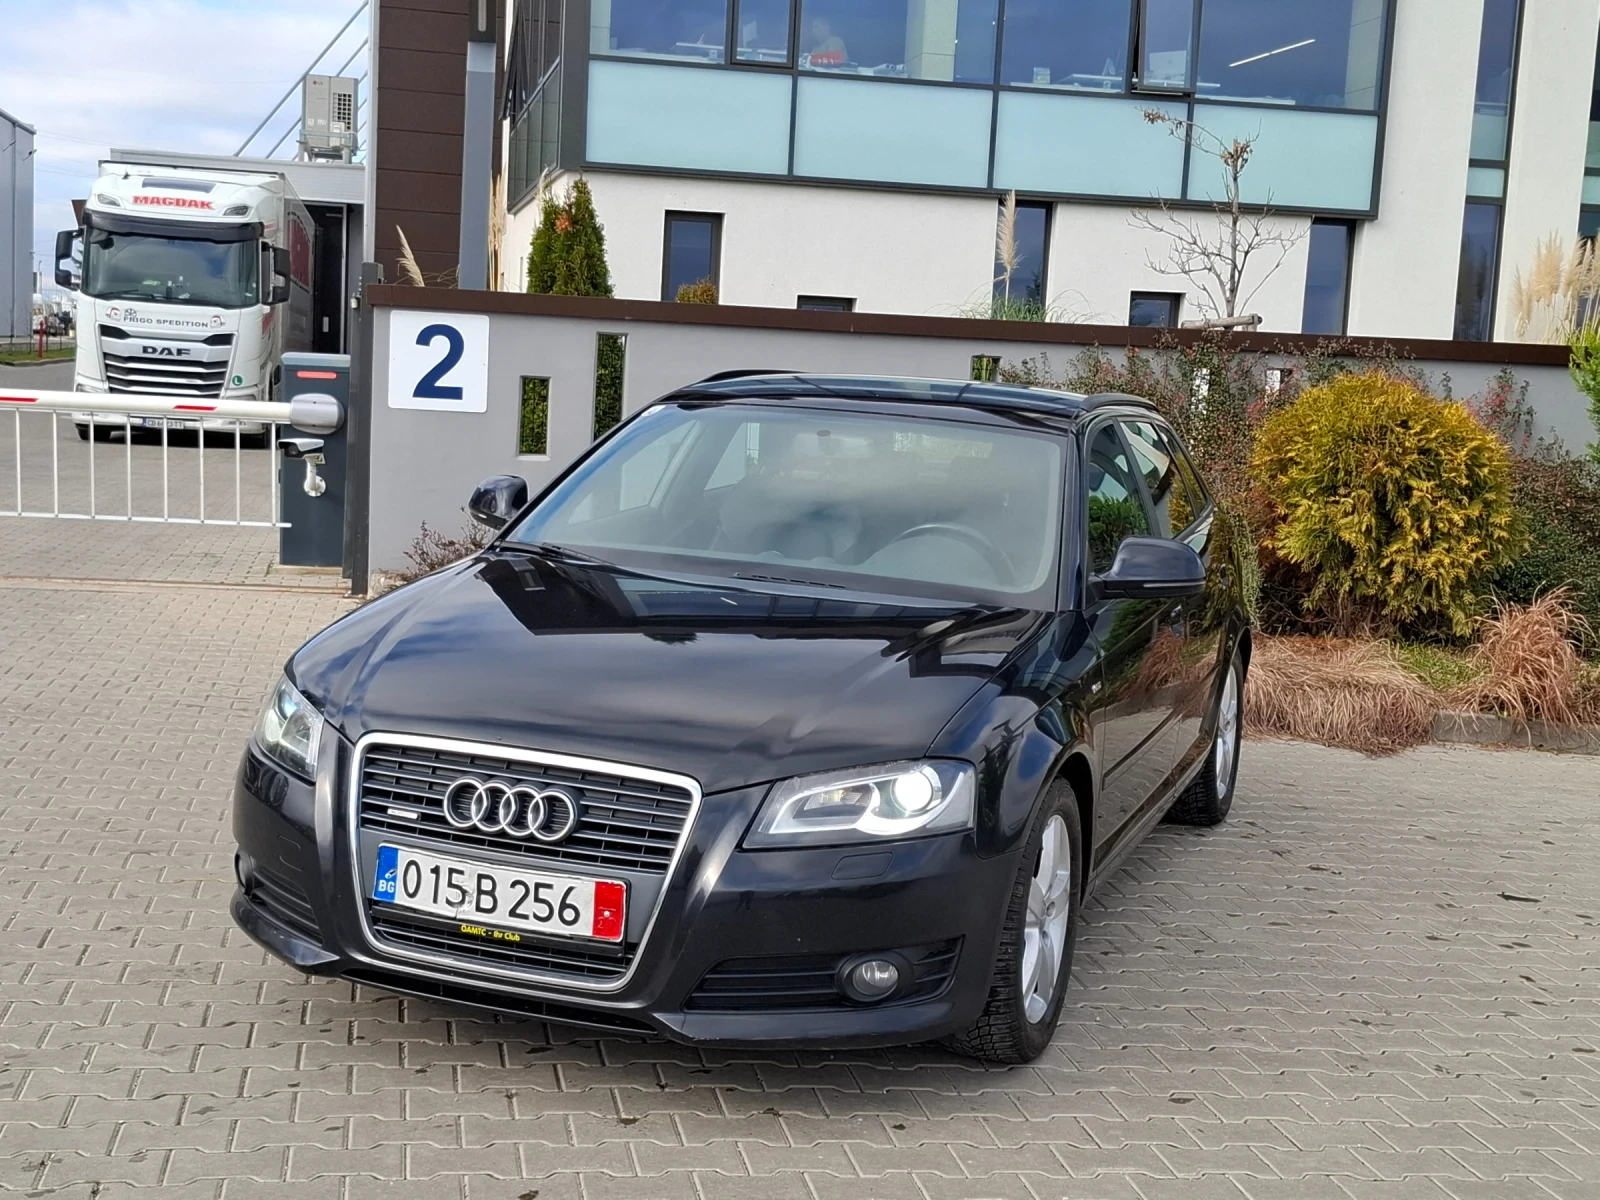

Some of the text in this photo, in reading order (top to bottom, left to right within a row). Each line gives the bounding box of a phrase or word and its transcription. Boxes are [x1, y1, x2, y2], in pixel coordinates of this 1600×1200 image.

[132, 195, 215, 210] MAGDAK
[123, 316, 208, 328] FRIGO SPEDITION
[142, 345, 191, 357] DAF
[412, 323, 465, 401] 2
[378, 879, 395, 893] BG
[504, 931, 521, 942] Club
